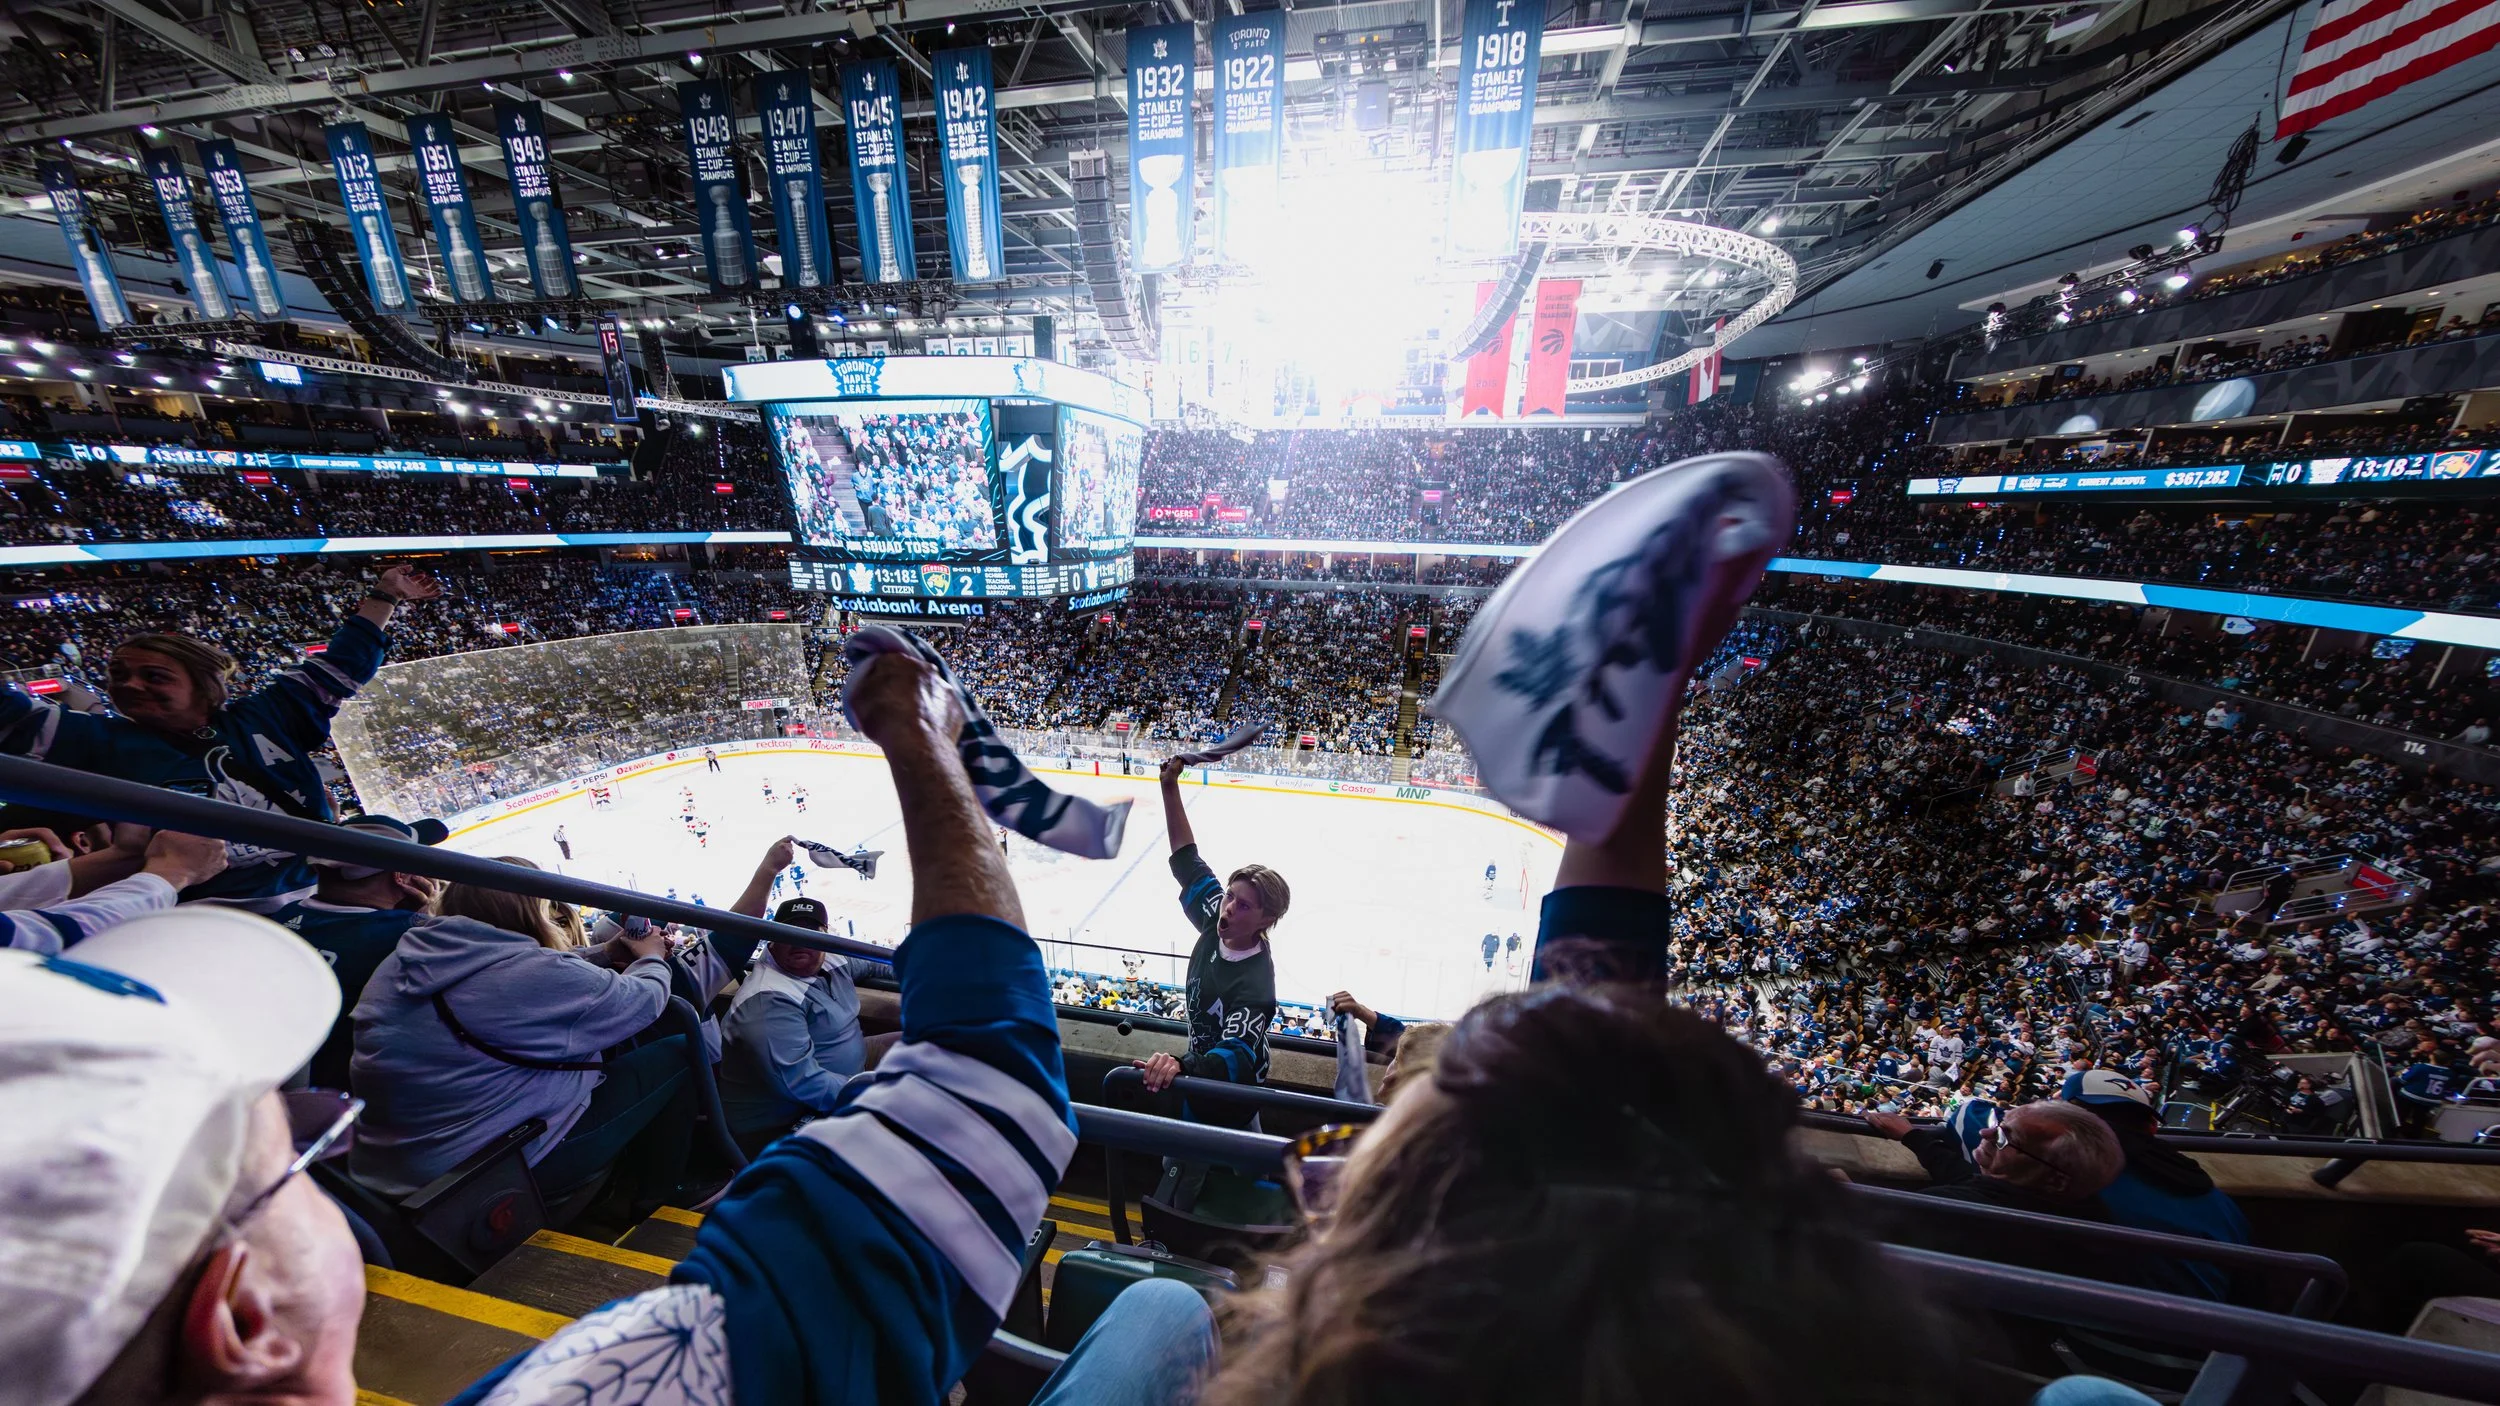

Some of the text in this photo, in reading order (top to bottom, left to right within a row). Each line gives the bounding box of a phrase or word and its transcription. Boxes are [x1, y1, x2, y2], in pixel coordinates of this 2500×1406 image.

[1227, 28, 1270, 41] TORONTO
[1475, 30, 1527, 70] 1918
[1224, 54, 1275, 91] 1922
[1472, 68, 1525, 88] STANLEY
[1136, 63, 1185, 99] 1932
[1226, 89, 1271, 107] STANLEY
[1484, 85, 1509, 101] CUP
[943, 86, 988, 121] 1942
[1138, 98, 1183, 115] STANLEY
[1469, 99, 1521, 115] CHAMPIONS
[851, 96, 894, 129] 1945
[1237, 106, 1258, 121] CUP
[689, 114, 731, 144] 1948
[767, 106, 807, 137] 1947
[947, 120, 986, 136] STANLEY
[1150, 114, 1171, 128] CUP
[1226, 118, 1271, 134] CHAMPIONS
[856, 129, 894, 144] STANLEY
[959, 134, 977, 147] CUP
[1138, 126, 1184, 141] CHAMPIONS
[507, 135, 546, 163] 1949
[773, 138, 808, 151] STANLEY
[868, 142, 886, 155] CUP
[420, 145, 454, 172] 1951
[784, 151, 800, 162] CUP
[858, 154, 896, 167] CHAMPIONS
[949, 146, 989, 161] CHAMPIONS
[337, 153, 373, 181] 1962
[707, 158, 724, 170] CUP
[211, 169, 244, 194] 1963
[700, 169, 735, 181] CHAMPIONS
[155, 176, 187, 201] 1964
[602, 332, 618, 354] 15
[835, 359, 877, 376] TORONTO
[843, 374, 872, 385] MAPLE
[844, 384, 873, 394] LEAFS
[92, 446, 106, 460] 0
[152, 450, 195, 464] 13:18
[244, 453, 254, 466] 2
[47, 458, 86, 472] 303
[165, 464, 226, 476] STREET
[2352, 458, 2407, 479] 13:18
[2483, 454, 2500, 477] 2
[371, 470, 400, 480] 304
[2165, 470, 2230, 488] $367,282
[2286, 464, 2302, 484] 0
[863, 540, 904, 554] SQUAD
[905, 541, 939, 554] TOSS
[831, 572, 842, 592] 0
[874, 568, 910, 584] 13:18
[1073, 571, 1080, 592] 0
[881, 585, 915, 594] CITIZEN
[960, 575, 973, 596] 2
[832, 596, 984, 615] Scotiabank Arena
[1068, 588, 1113, 611] Scotiabank
[747, 699, 784, 709] POINTSBET
[252, 733, 296, 766] A
[756, 740, 792, 750] redtag
[808, 740, 845, 750] Molson
[2403, 741, 2427, 755] 114
[677, 751, 689, 759] LG
[616, 759, 655, 776] OZEMPIC
[582, 772, 608, 785] PEPSI
[1341, 784, 1376, 794] Castrol
[1396, 787, 1432, 800] MNP
[505, 788, 560, 811] Scotiabank
[792, 903, 814, 911] HLD
[1207, 997, 1224, 1027] A
[1222, 1006, 1266, 1050] 34
[2426, 1079, 2444, 1095] 16
